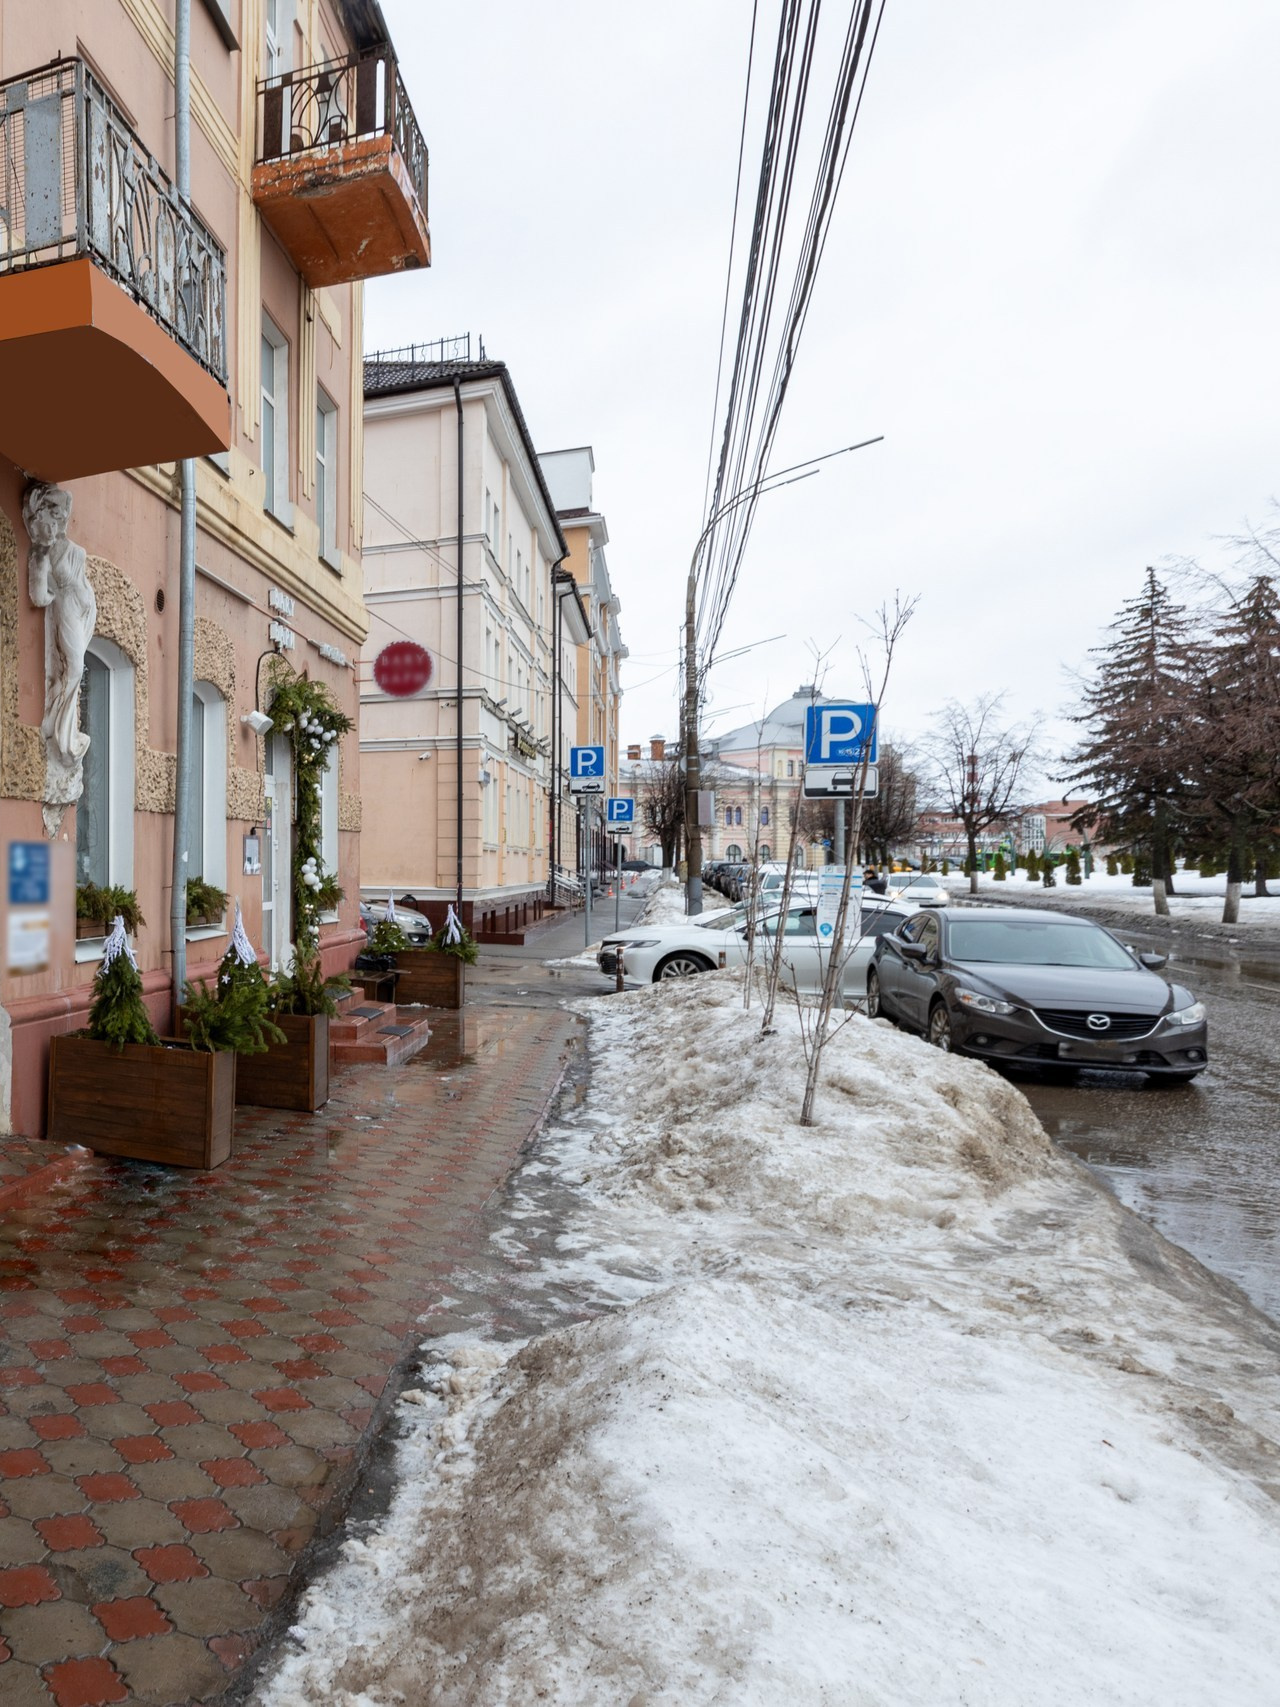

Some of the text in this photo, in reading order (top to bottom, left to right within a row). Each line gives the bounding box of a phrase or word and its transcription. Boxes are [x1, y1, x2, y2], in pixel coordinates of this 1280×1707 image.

[821, 710, 862, 759] P
[577, 749, 597, 775] P
[613, 800, 628, 820] P
